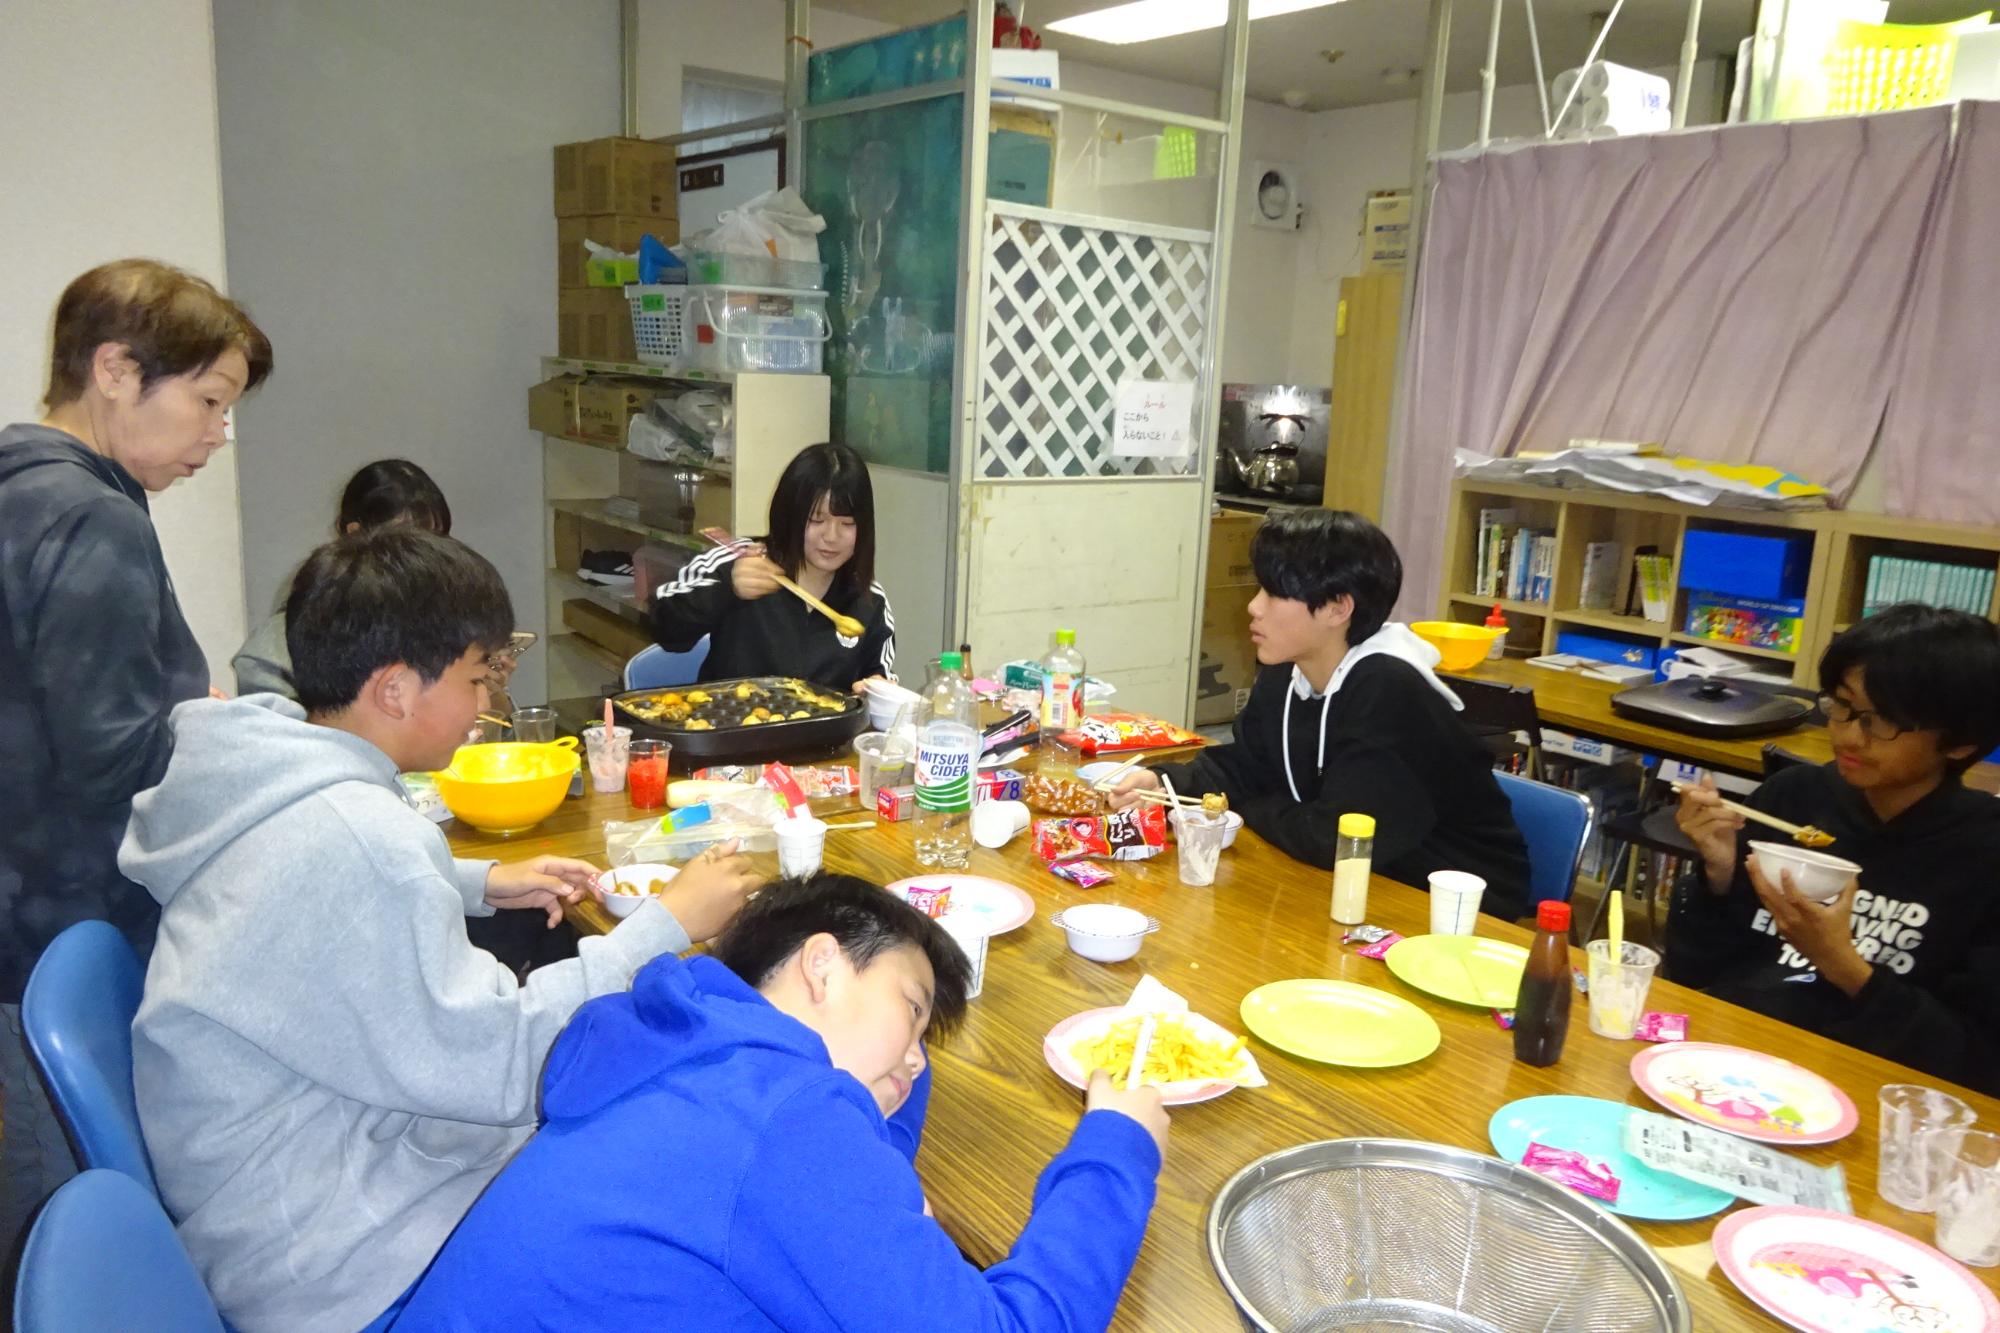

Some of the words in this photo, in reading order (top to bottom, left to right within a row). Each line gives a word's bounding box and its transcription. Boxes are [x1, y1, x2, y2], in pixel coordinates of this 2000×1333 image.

[1123, 412, 1150, 422] ここから
[920, 750, 969, 765] MITSUYA
[930, 765, 969, 777] CIDER
[1009, 780, 1020, 800] 8
